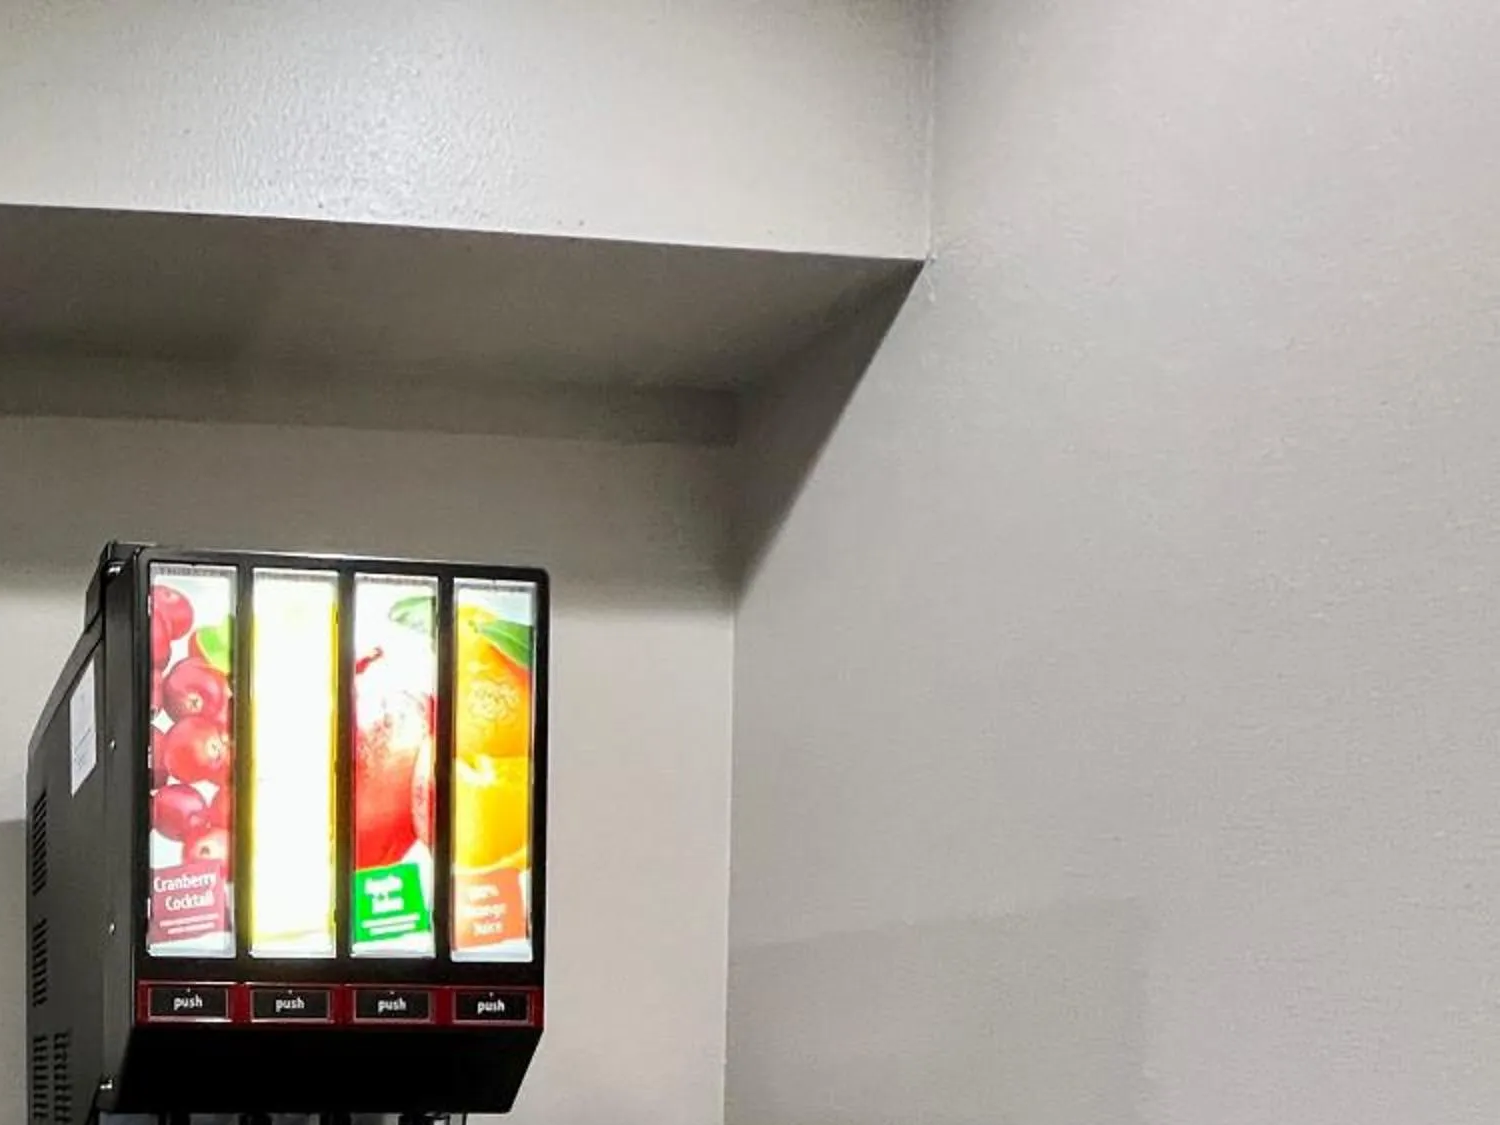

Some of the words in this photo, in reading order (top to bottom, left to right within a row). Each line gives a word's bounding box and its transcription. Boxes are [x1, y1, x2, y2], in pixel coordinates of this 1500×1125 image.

[153, 873, 217, 893] Cranberry
[165, 889, 215, 911] Cocktail
[173, 994, 203, 1011] push
[275, 997, 305, 1013] push
[377, 998, 407, 1013] push
[477, 1000, 506, 1015] push
